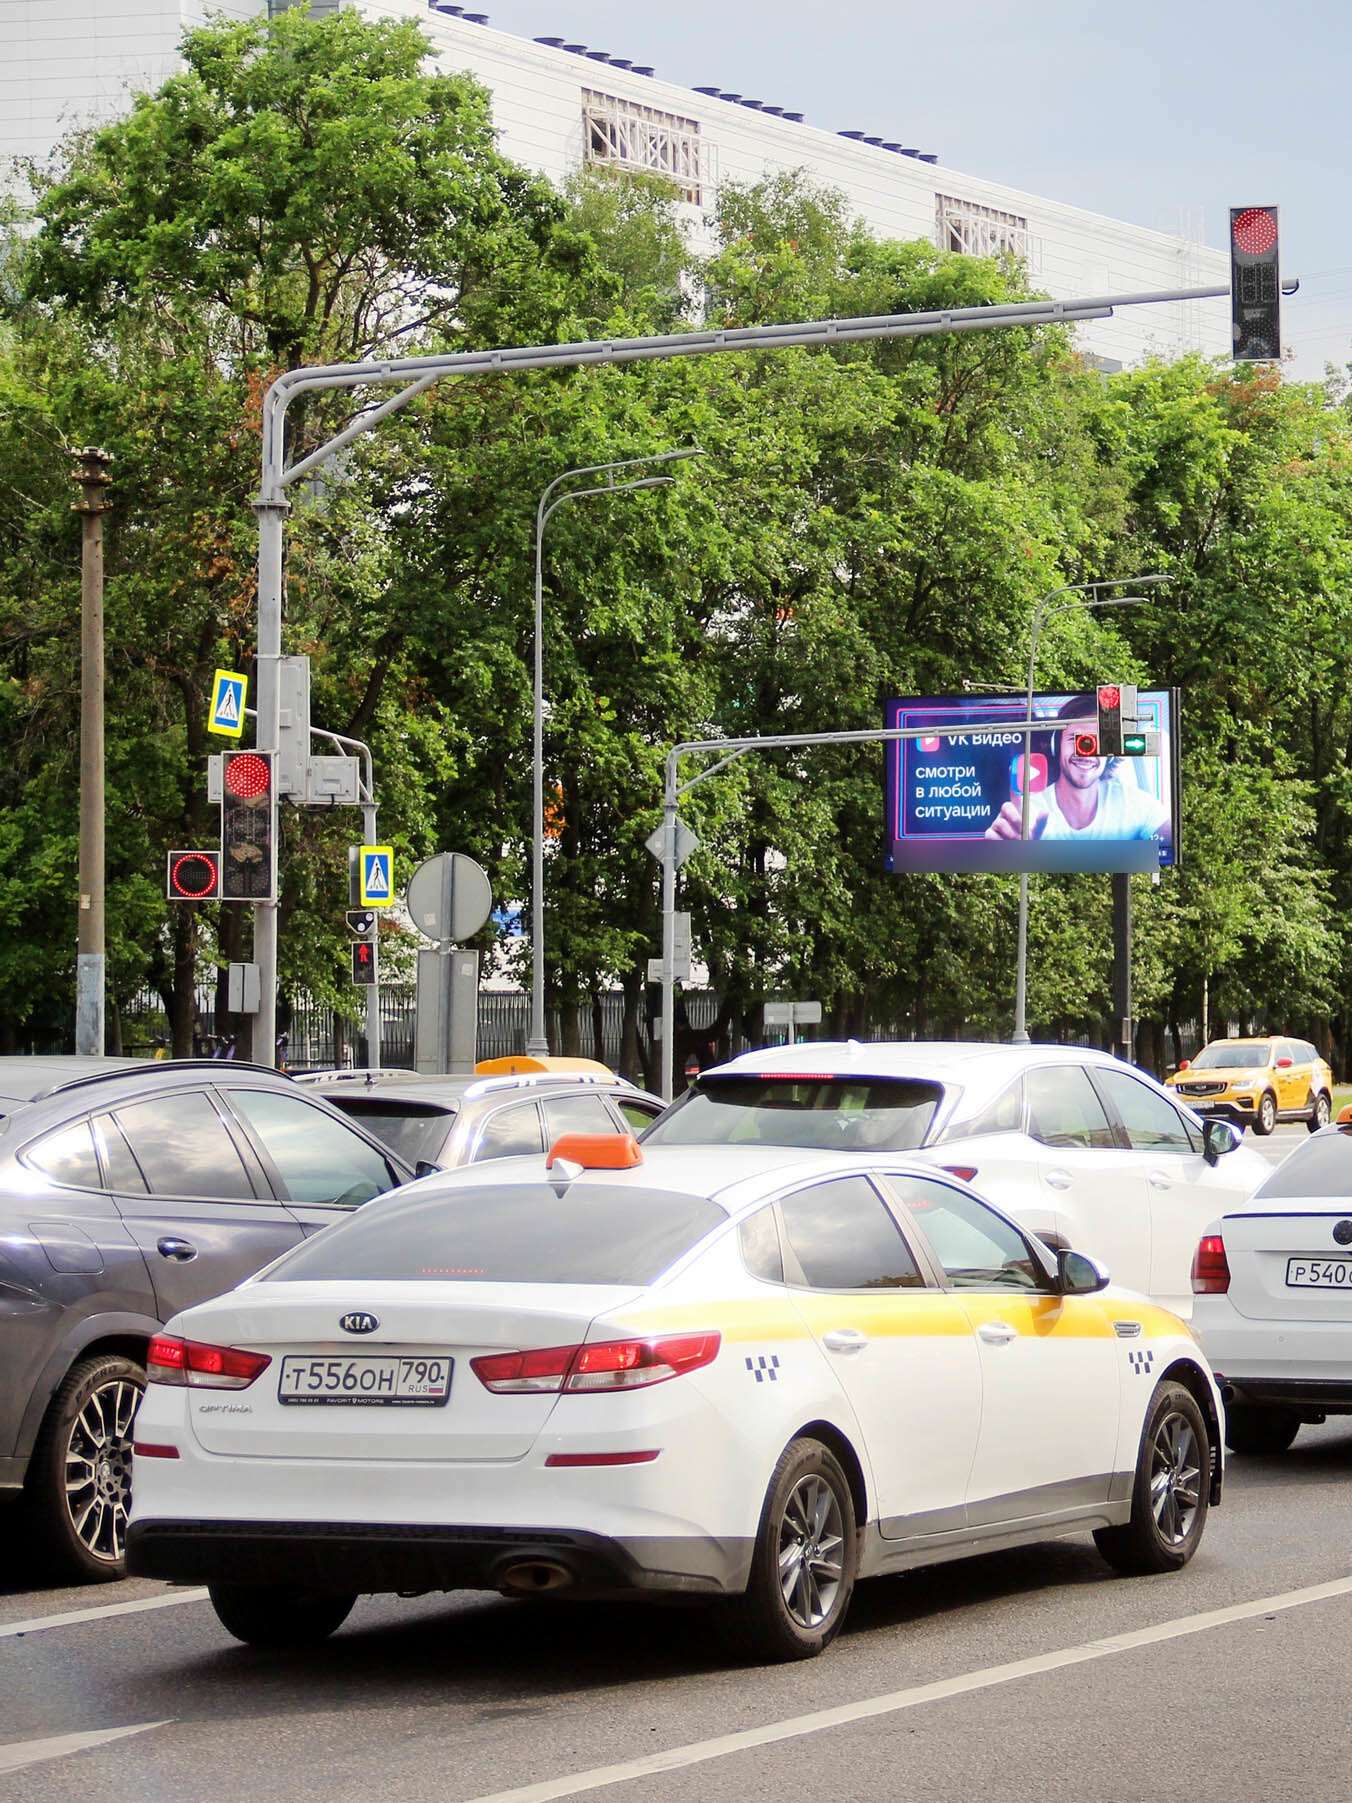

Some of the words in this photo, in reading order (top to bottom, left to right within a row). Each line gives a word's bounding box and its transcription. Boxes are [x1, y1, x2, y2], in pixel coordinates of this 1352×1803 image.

[947, 735, 969, 746] VK
[972, 732, 1022, 747] Видео
[915, 766, 976, 781] смотри
[915, 786, 925, 798] в
[928, 782, 982, 798] любой
[915, 804, 991, 821] ситуации
[344, 1316, 373, 1329] KIA
[292, 1362, 395, 1391] Т556ОН
[401, 1361, 442, 1384] 790
[408, 1384, 428, 1393] RUS
